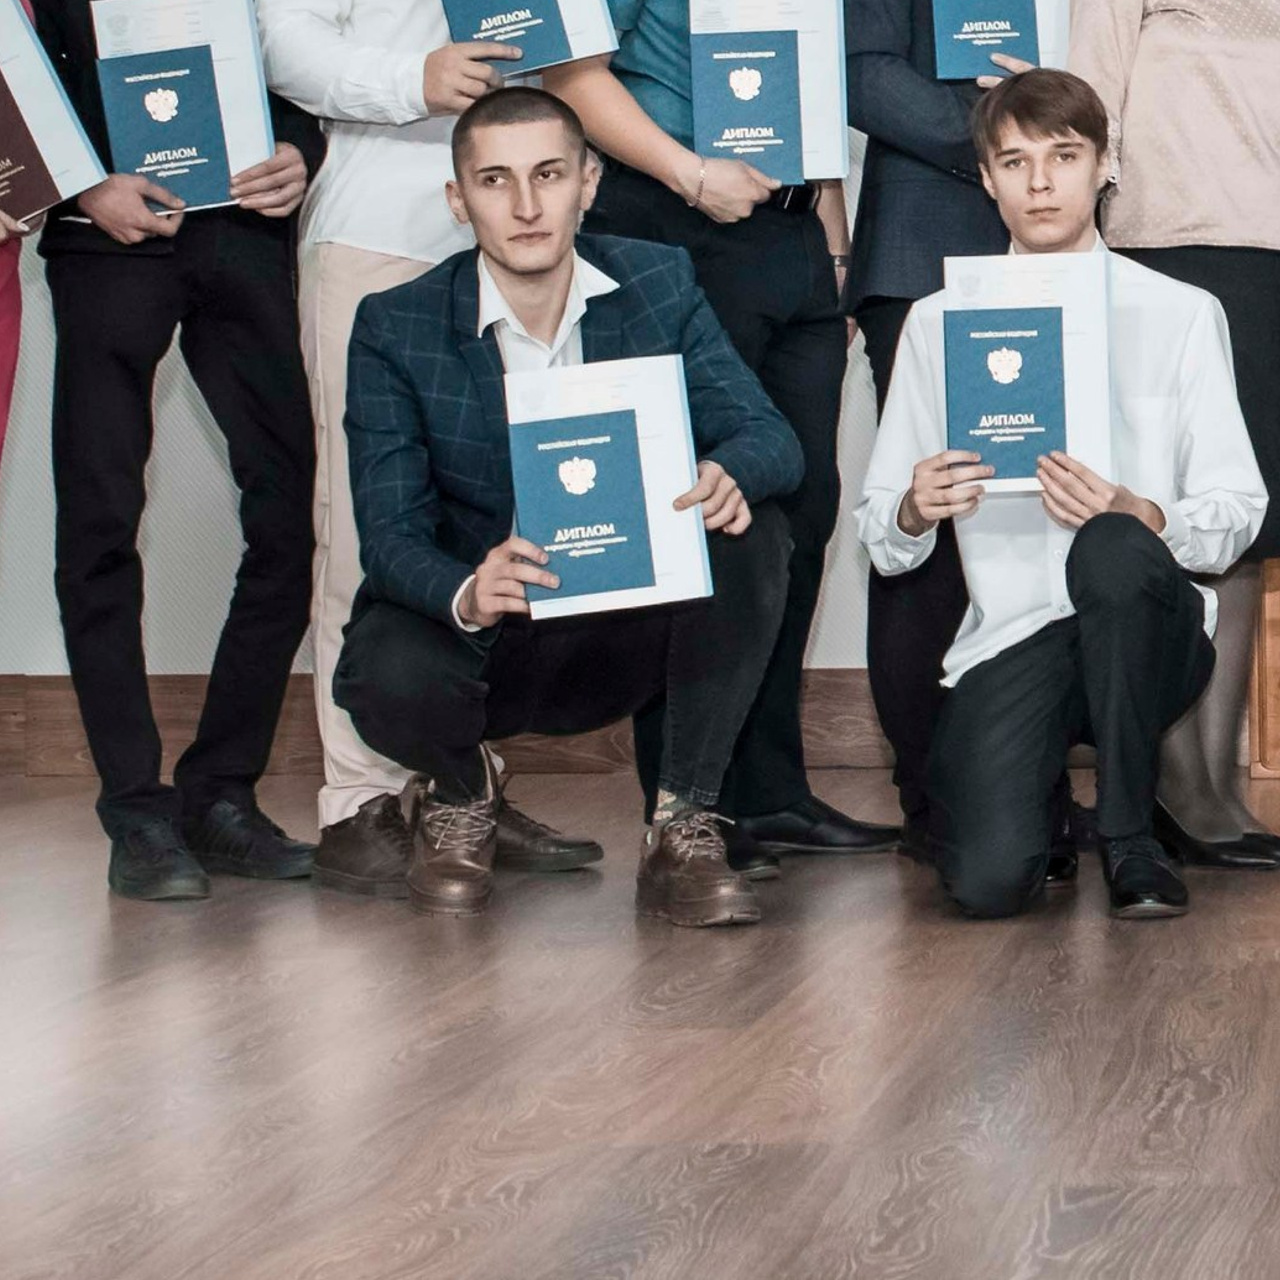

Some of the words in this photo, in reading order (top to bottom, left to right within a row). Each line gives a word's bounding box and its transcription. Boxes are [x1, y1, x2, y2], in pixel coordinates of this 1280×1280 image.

[480, 9, 532, 31] ДИПЛОМ
[962, 20, 1011, 32] ДИПЛОМ
[722, 127, 774, 140] ДИПЛОМ
[143, 146, 198, 165] ДИПЛОМ
[979, 413, 1035, 427] ДИПЛОМ
[554, 523, 616, 542] ДИПЛОМ
